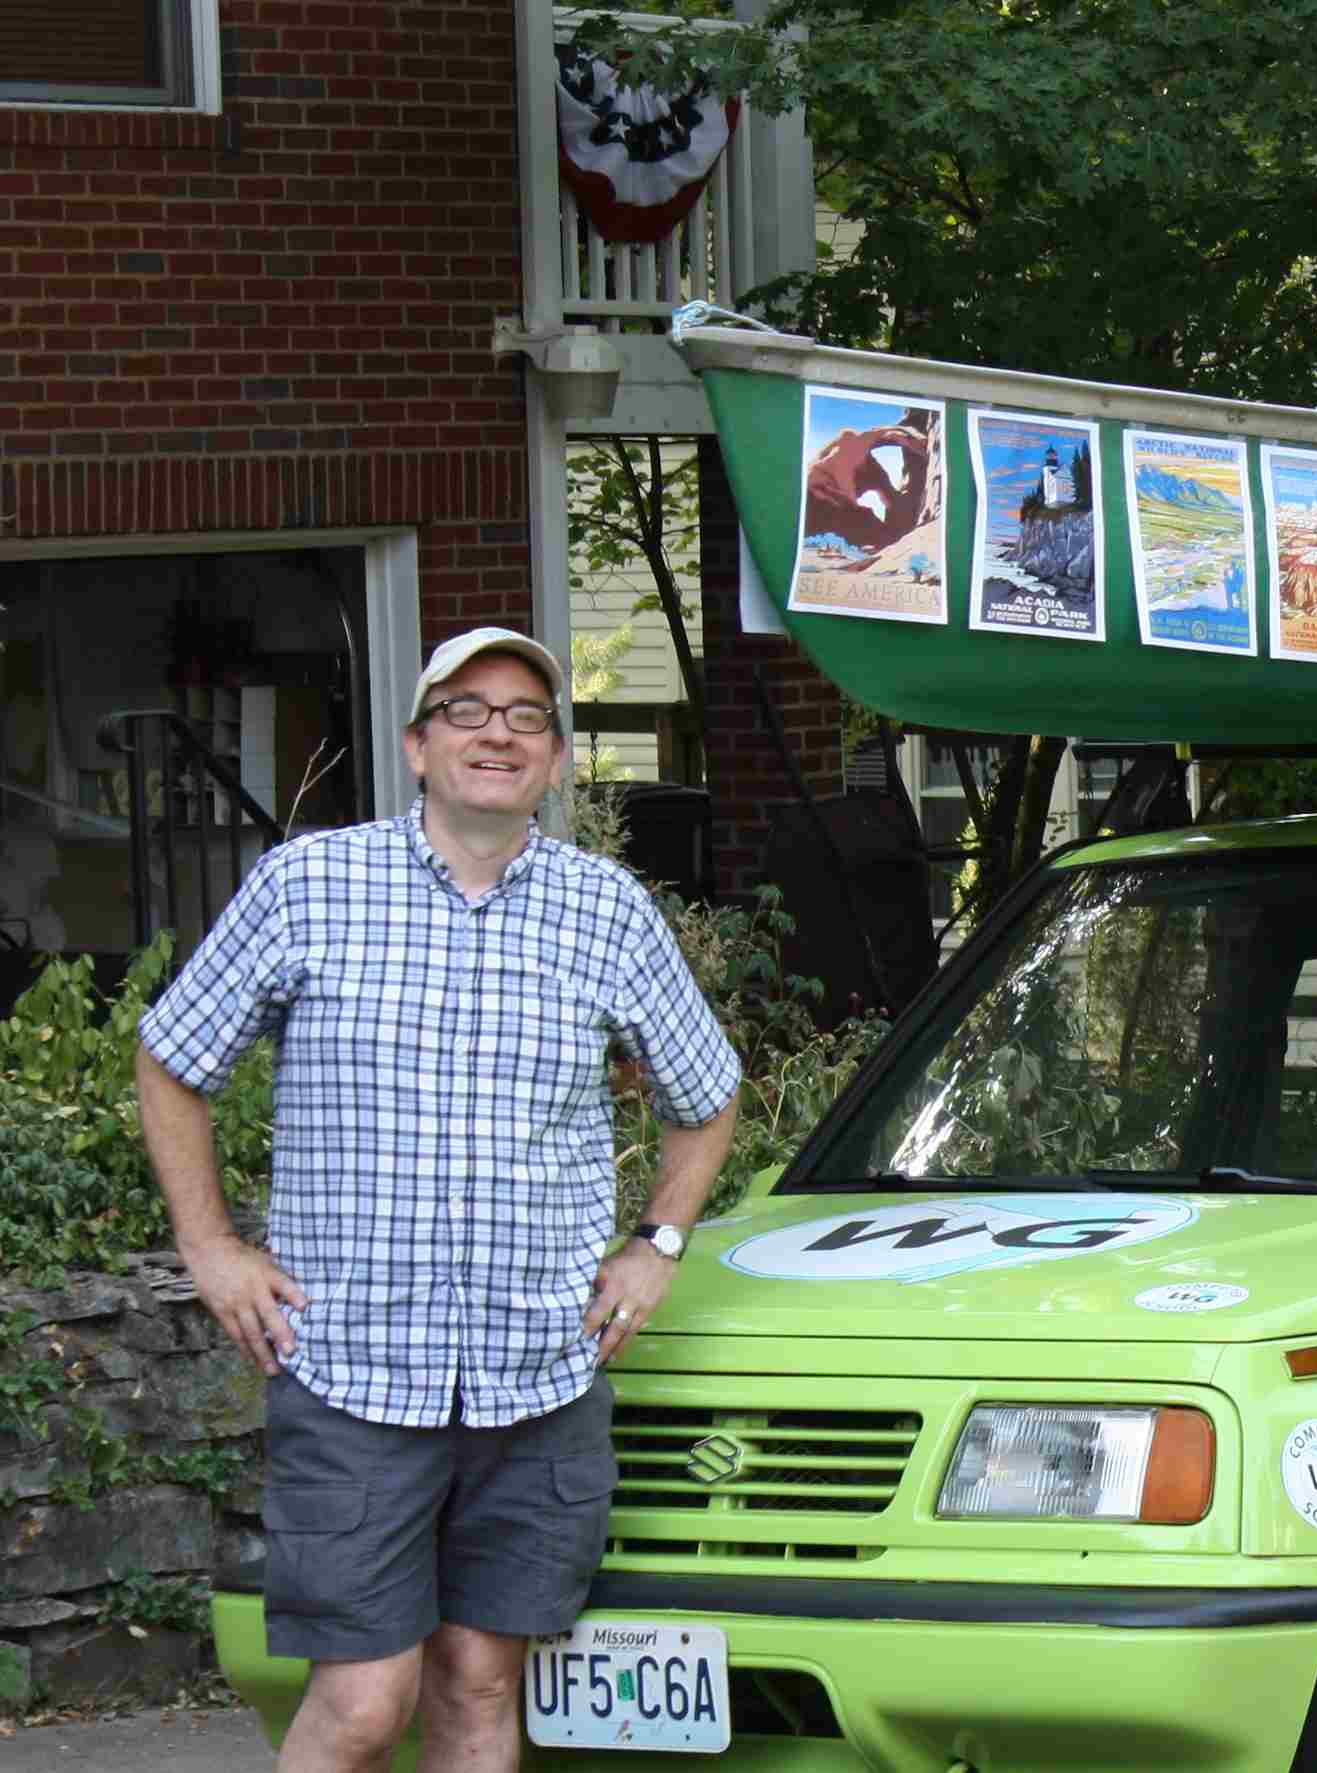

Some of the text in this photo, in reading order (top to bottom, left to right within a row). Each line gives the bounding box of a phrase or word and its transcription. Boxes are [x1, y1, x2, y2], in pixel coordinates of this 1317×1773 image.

[799, 576, 941, 609] SEE AMERICA
[1014, 595, 1065, 610] ACADIA
[1050, 609, 1089, 620] PARK
[801, 1217, 1156, 1249] WG
[592, 1628, 658, 1645] Missouri
[533, 1652, 716, 1722] UF5 C6A
